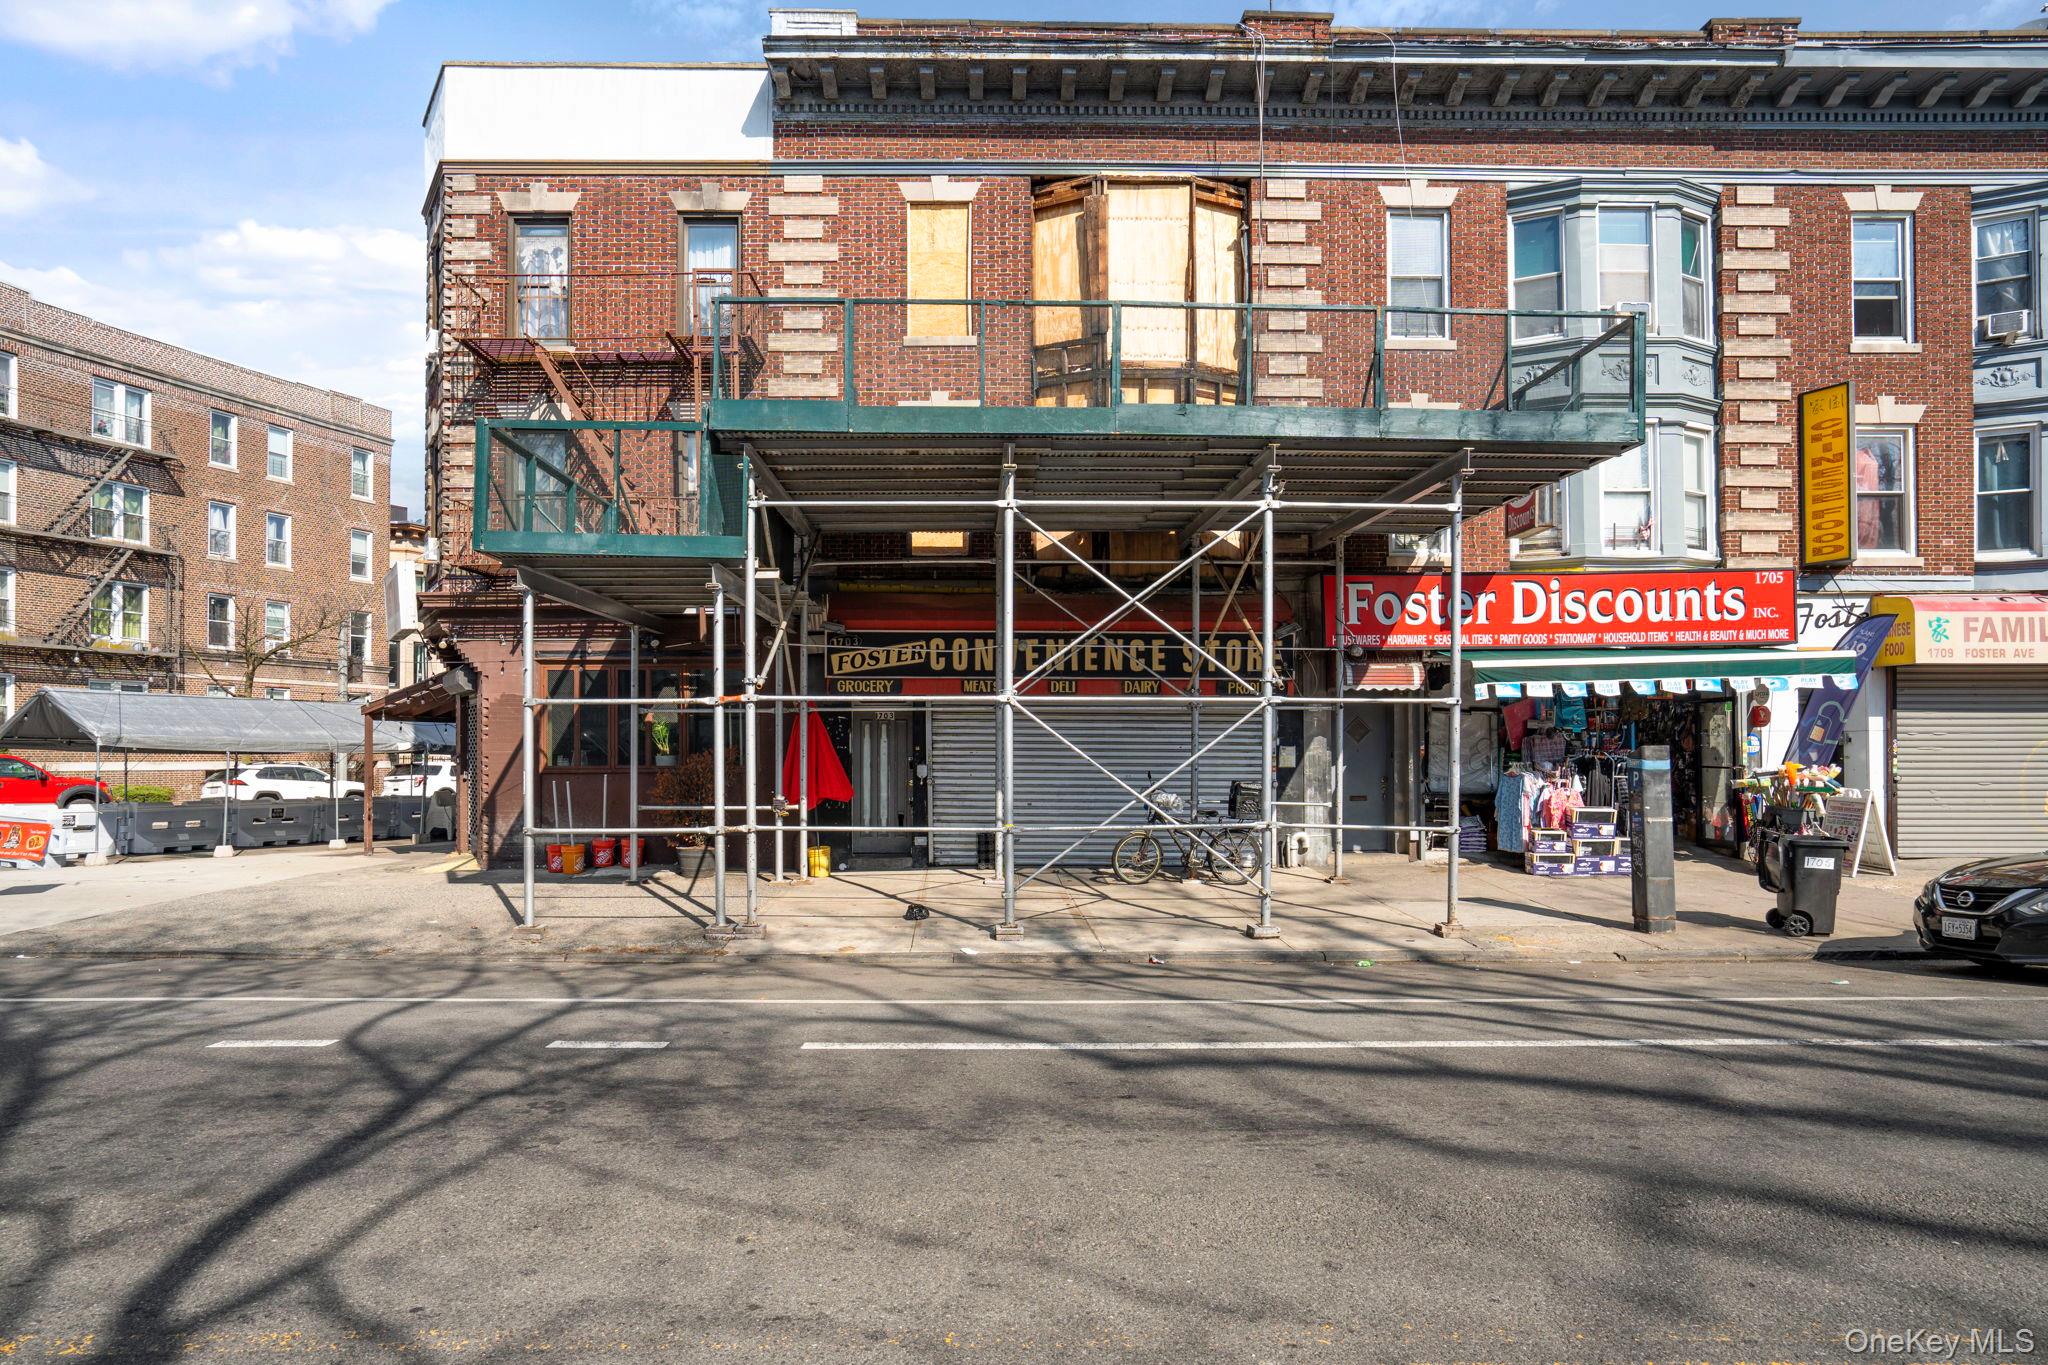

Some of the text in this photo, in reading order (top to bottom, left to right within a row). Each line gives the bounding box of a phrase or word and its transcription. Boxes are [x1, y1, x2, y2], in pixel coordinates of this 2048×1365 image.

[1811, 417, 1844, 505] CHINESE
[1811, 505, 1845, 557] FOOD
[1755, 571, 1784, 584] 1705
[1345, 577, 1747, 626] Foster Discounts
[1753, 606, 1779, 618] INC.
[1332, 628, 1789, 646] HUSEWARES HARDWARE SEASAL ITEMS PARTY GOODS STATIONARY HOUSEHOLD ITEMS HEALTH & BEAUTY & MUCH MORE
[1927, 616, 1951, 643] 家
[836, 644, 925, 672] FOSTER
[1182, 638, 1284, 673] STORE
[1884, 641, 1905, 657] FOOD
[1927, 647, 2035, 659] 1709 FOSTER AVE
[836, 680, 894, 693] GROCERY
[1050, 680, 1076, 693] DELI
[1124, 680, 1160, 693] DAIRY
[875, 712, 894, 720] 1703
[1805, 856, 1833, 868] 1705
